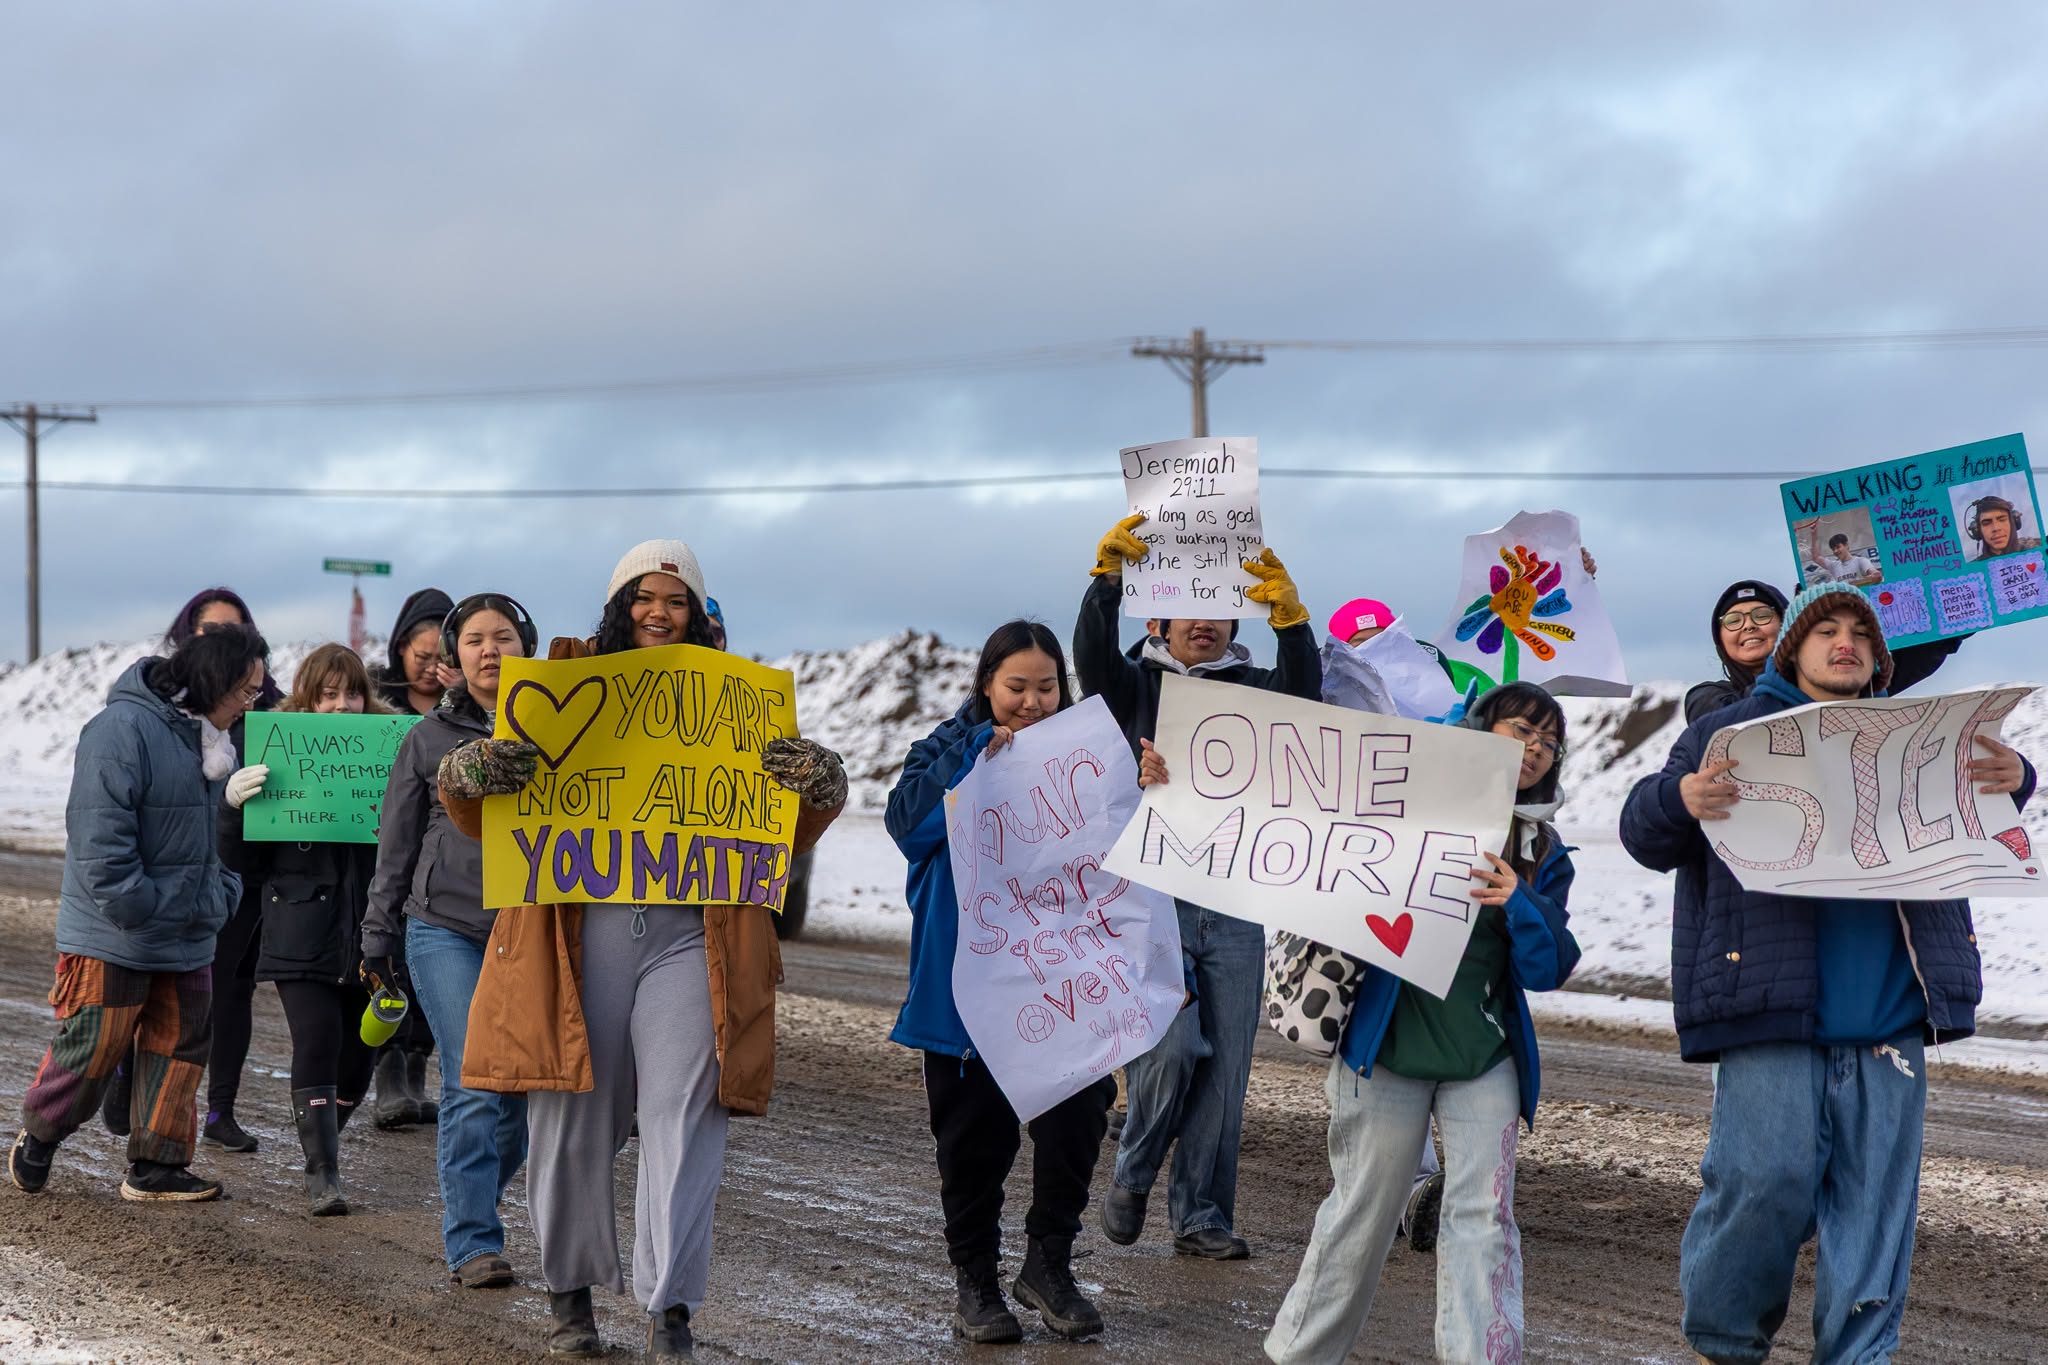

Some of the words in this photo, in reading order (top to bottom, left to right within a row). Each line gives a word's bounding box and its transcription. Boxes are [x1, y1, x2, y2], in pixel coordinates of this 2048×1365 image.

[1123, 442, 1235, 479] Jeremiah
[1170, 477, 1225, 498] 29:11
[1791, 464, 1922, 513] WALKING
[1933, 463, 1953, 486] in
[1961, 453, 2020, 478] honor
[1159, 504, 1186, 531] long
[1196, 510, 1217, 525] as
[1227, 506, 1254, 530] god
[1876, 514, 1898, 526] my
[1883, 516, 1937, 541] HARVEY
[1941, 515, 1950, 529] &
[1176, 532, 1228, 553] waking
[1237, 535, 1262, 552] you
[1892, 539, 1960, 567] NATHANIEL
[1194, 551, 1228, 568] still
[1238, 552, 1262, 569] ha
[1999, 565, 2024, 577] IT'S
[1941, 585, 1971, 596] men's
[2002, 572, 2029, 586] OKAY!
[2005, 590, 2014, 598] TO
[2019, 582, 2036, 593] NOT
[1126, 583, 1139, 597] a
[1152, 580, 1181, 600] plan
[1192, 577, 1221, 599] for
[1233, 585, 1252, 608] yo
[1505, 587, 1529, 600] YOU
[1898, 589, 1914, 598] THE
[1943, 591, 1975, 607] mental
[2008, 596, 2018, 604] BE
[2020, 588, 2040, 600] OKAY
[1504, 600, 1523, 617] ARE
[1881, 599, 1928, 629] STIGMA
[1945, 600, 1976, 614] health
[1520, 632, 1550, 655] KIND
[613, 669, 706, 747] YOU
[701, 674, 785, 753] ARE
[259, 723, 365, 766] ALWAYS
[1190, 713, 1411, 818] ONE
[262, 789, 308, 801] THERE
[323, 790, 334, 798] IS
[518, 766, 625, 822] NOT
[633, 764, 783, 835] ALONE
[282, 810, 339, 824] THERE
[351, 812, 365, 824] IS
[951, 748, 1106, 912] your
[511, 825, 622, 904] YOU
[631, 831, 790, 910] MATTER
[1141, 806, 1478, 924] MORE
[1016, 953, 1129, 1044] over
[1088, 995, 1153, 1074] yet
